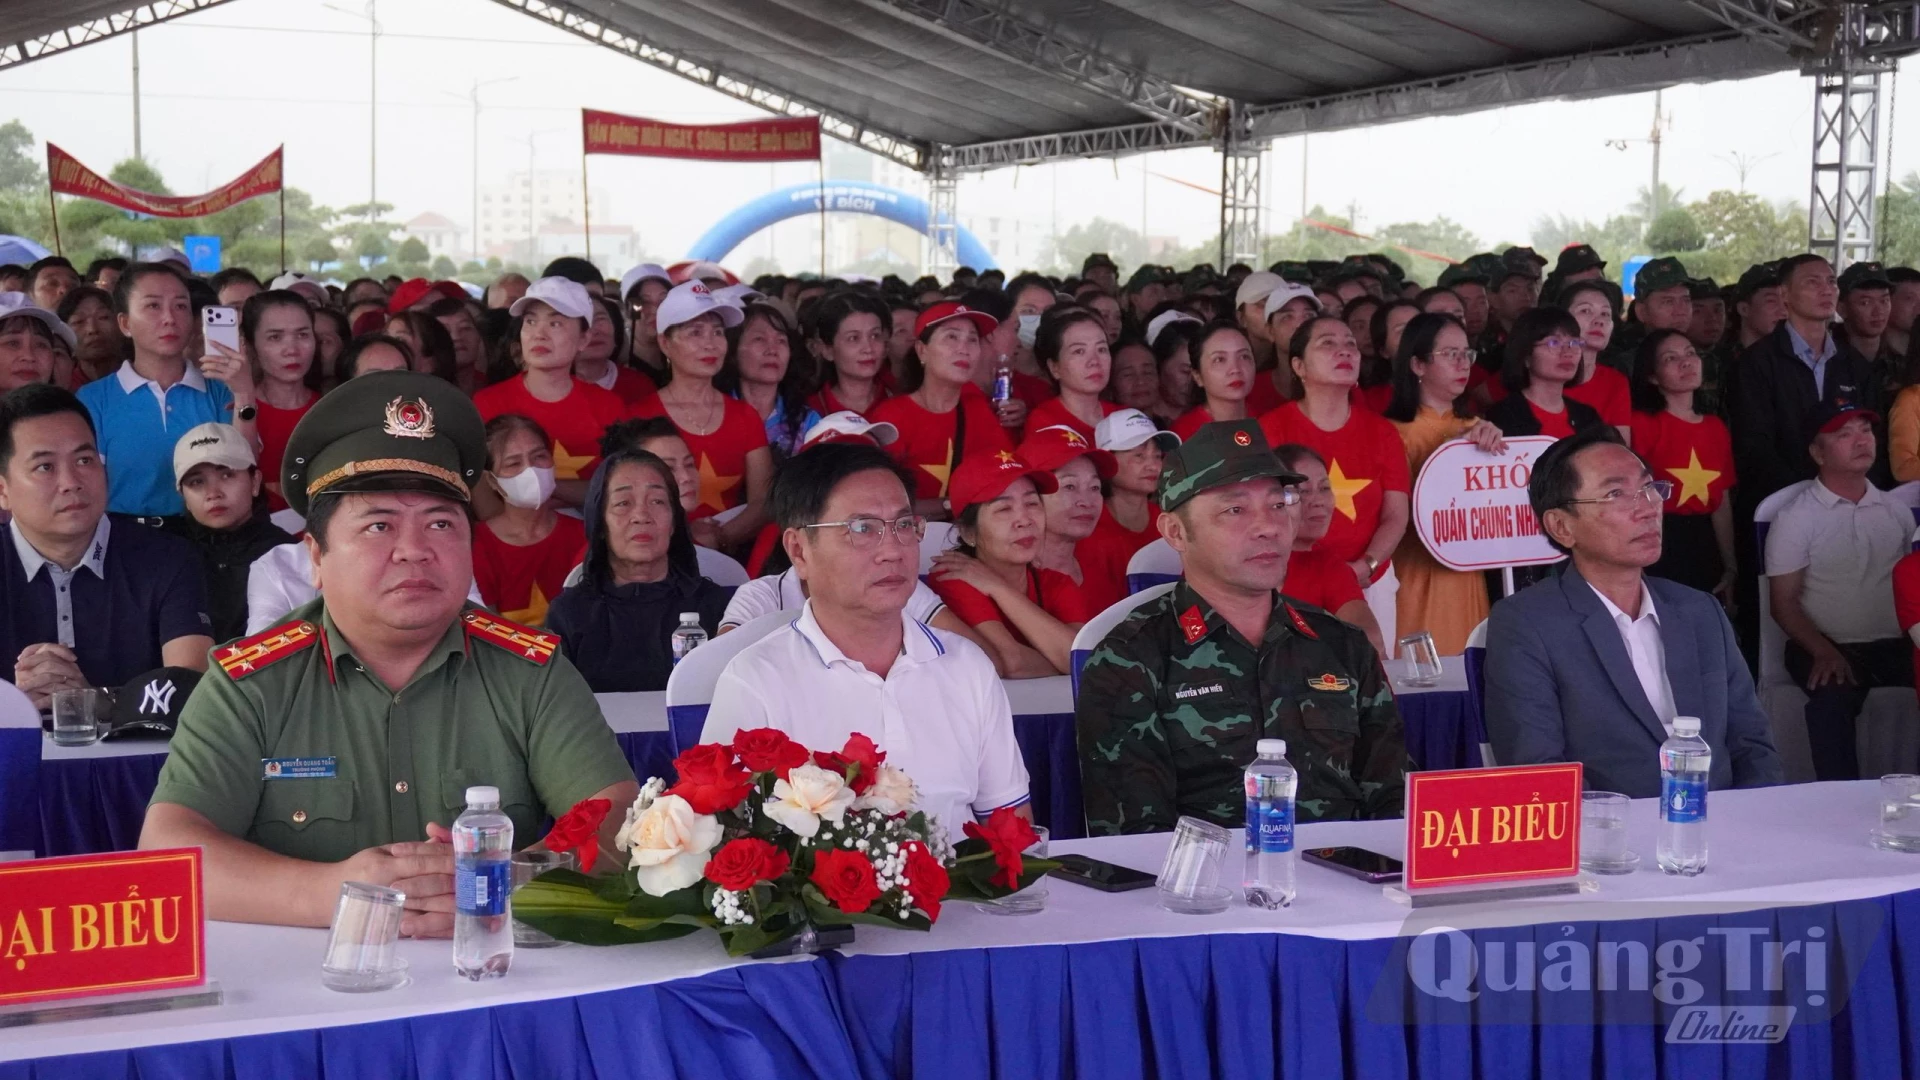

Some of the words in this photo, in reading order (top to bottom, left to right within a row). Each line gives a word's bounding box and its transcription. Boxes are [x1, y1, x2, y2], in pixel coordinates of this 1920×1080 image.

[1463, 452, 1532, 491] KHỐ
[1470, 499, 1513, 541] CHÚNG
[1258, 823, 1292, 835] AQUAFINA
[1421, 807, 1482, 859] ĐẠI
[1490, 791, 1569, 844] BIỂU
[69, 884, 183, 952] BIỂU
